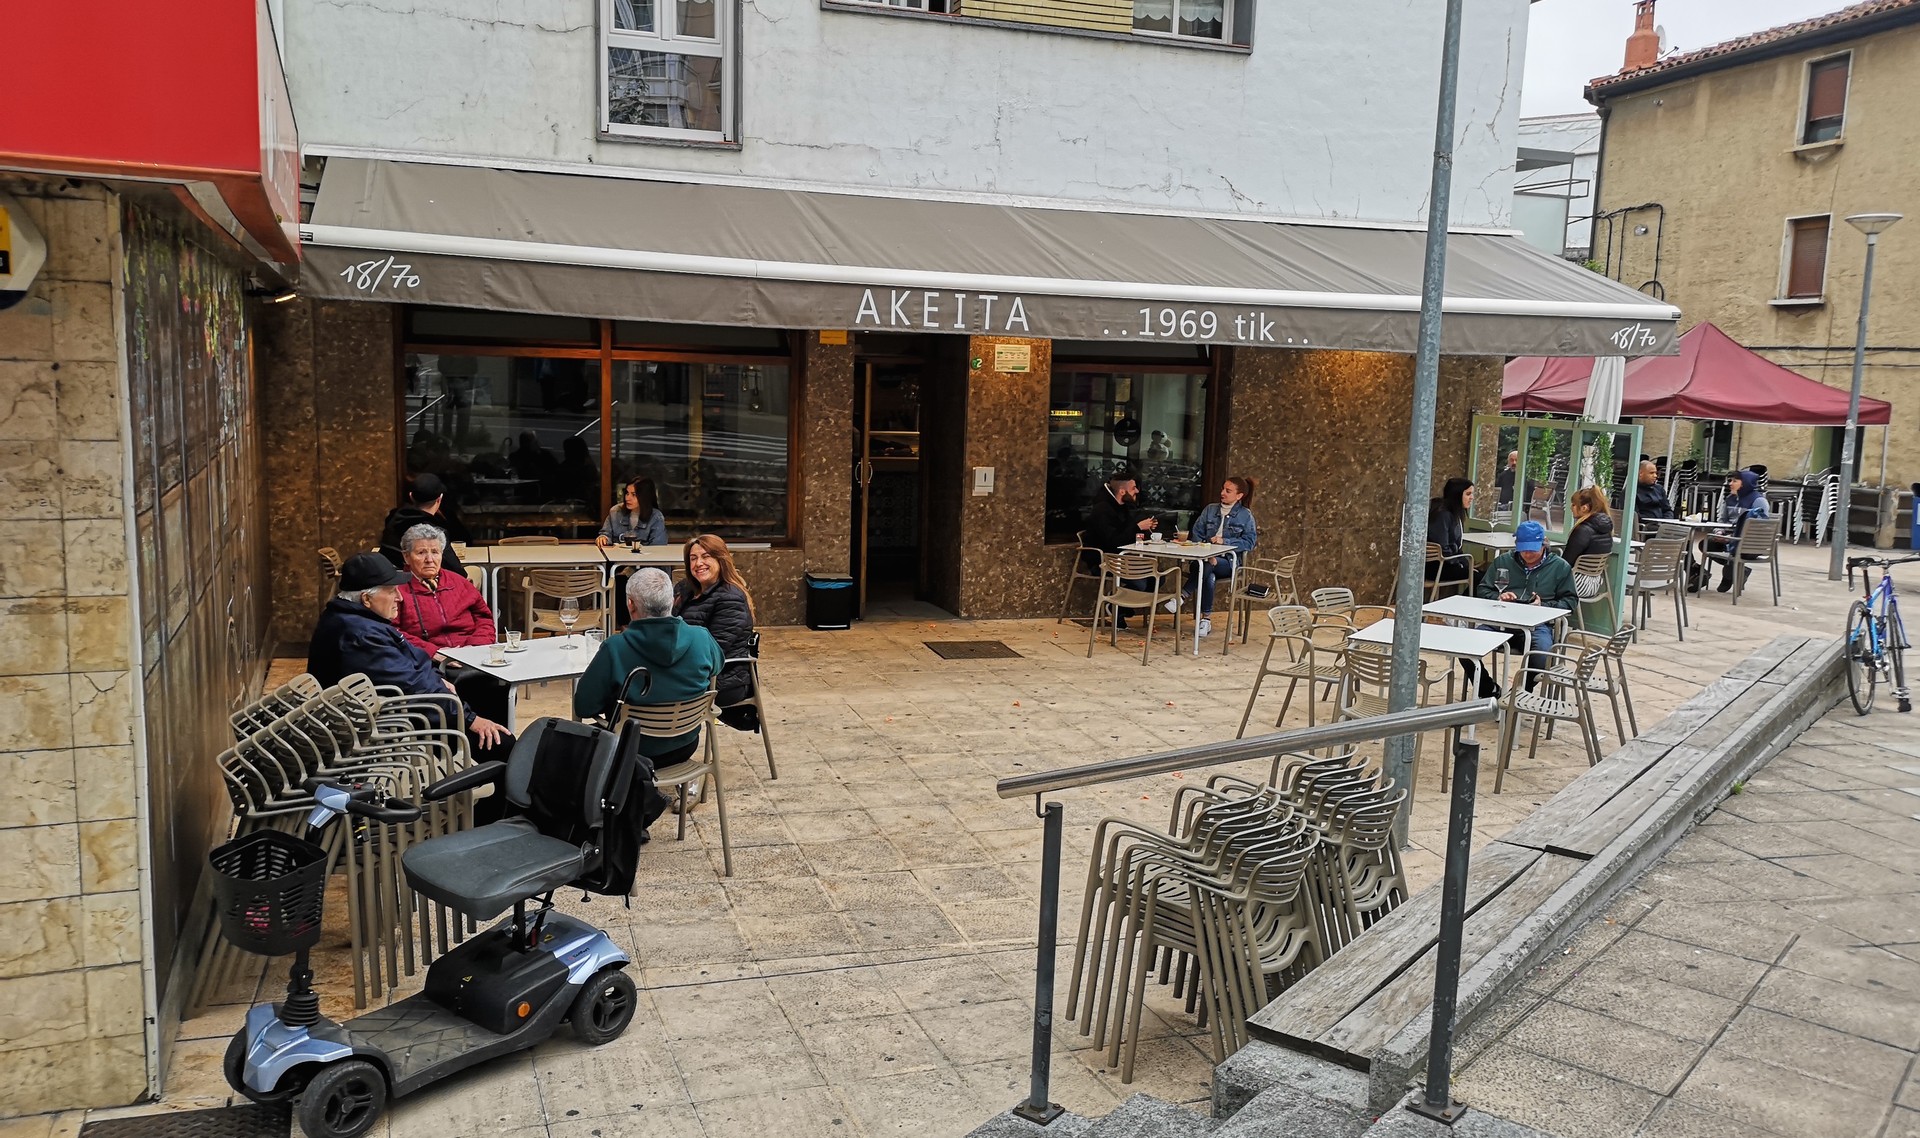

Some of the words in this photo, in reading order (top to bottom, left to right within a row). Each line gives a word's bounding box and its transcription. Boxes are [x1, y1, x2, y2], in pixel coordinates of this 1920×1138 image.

[340, 255, 420, 294] 18/70
[855, 288, 1030, 332] AKEITA
[1610, 322, 1656, 352] 18/70
